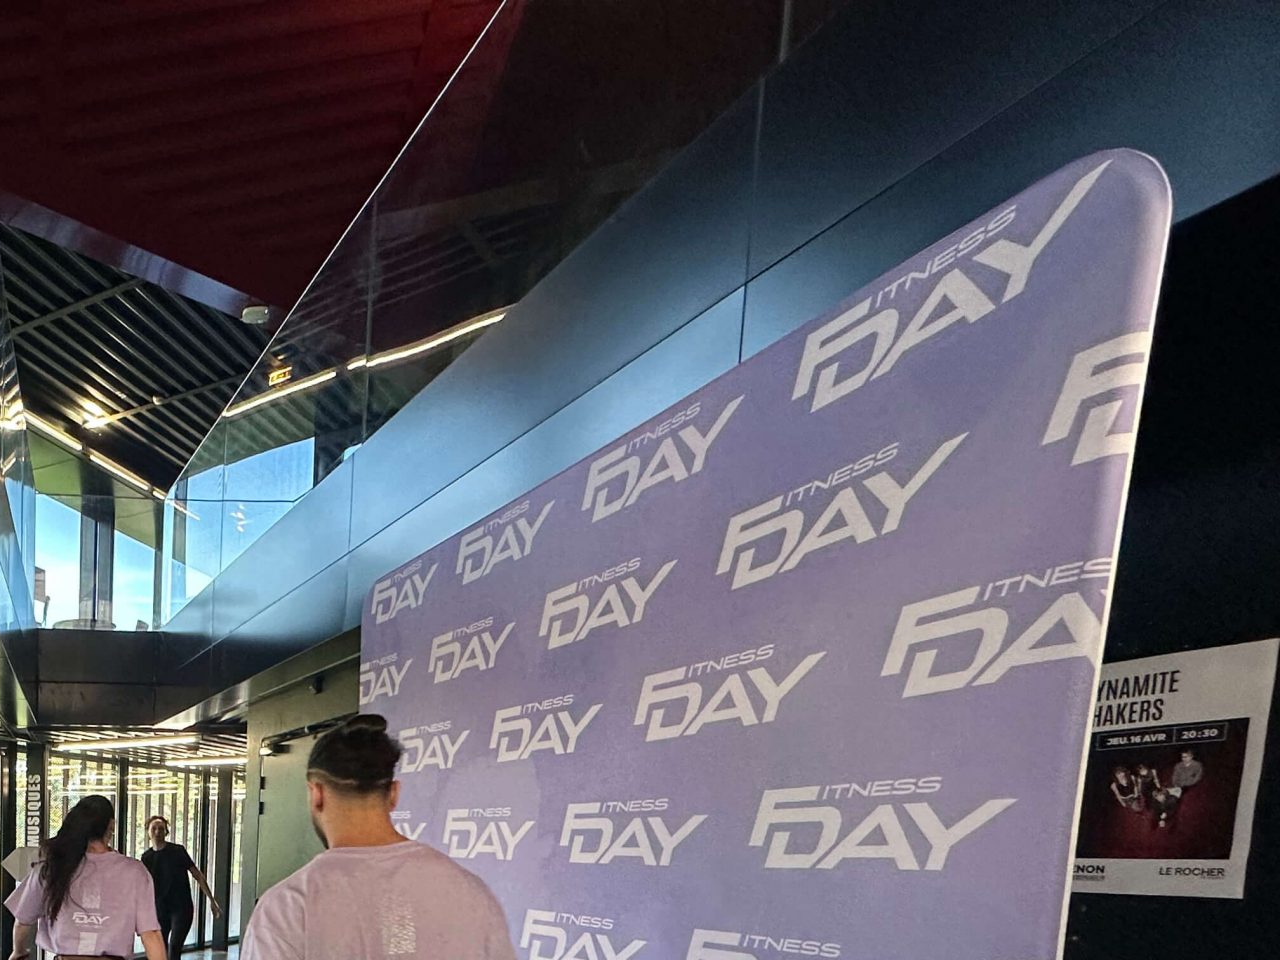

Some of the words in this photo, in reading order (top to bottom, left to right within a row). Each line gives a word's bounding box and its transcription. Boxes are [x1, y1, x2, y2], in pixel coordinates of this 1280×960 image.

[1097, 669, 1181, 702] YNAMITE
[1093, 698, 1164, 727] HAKERS
[1142, 733, 1167, 744] AVR
[1180, 728, 1218, 740] 20:30
[27, 774, 41, 848] MUSIQUES
[1159, 867, 1172, 876] LE
[1174, 867, 1225, 877] ROCHER
